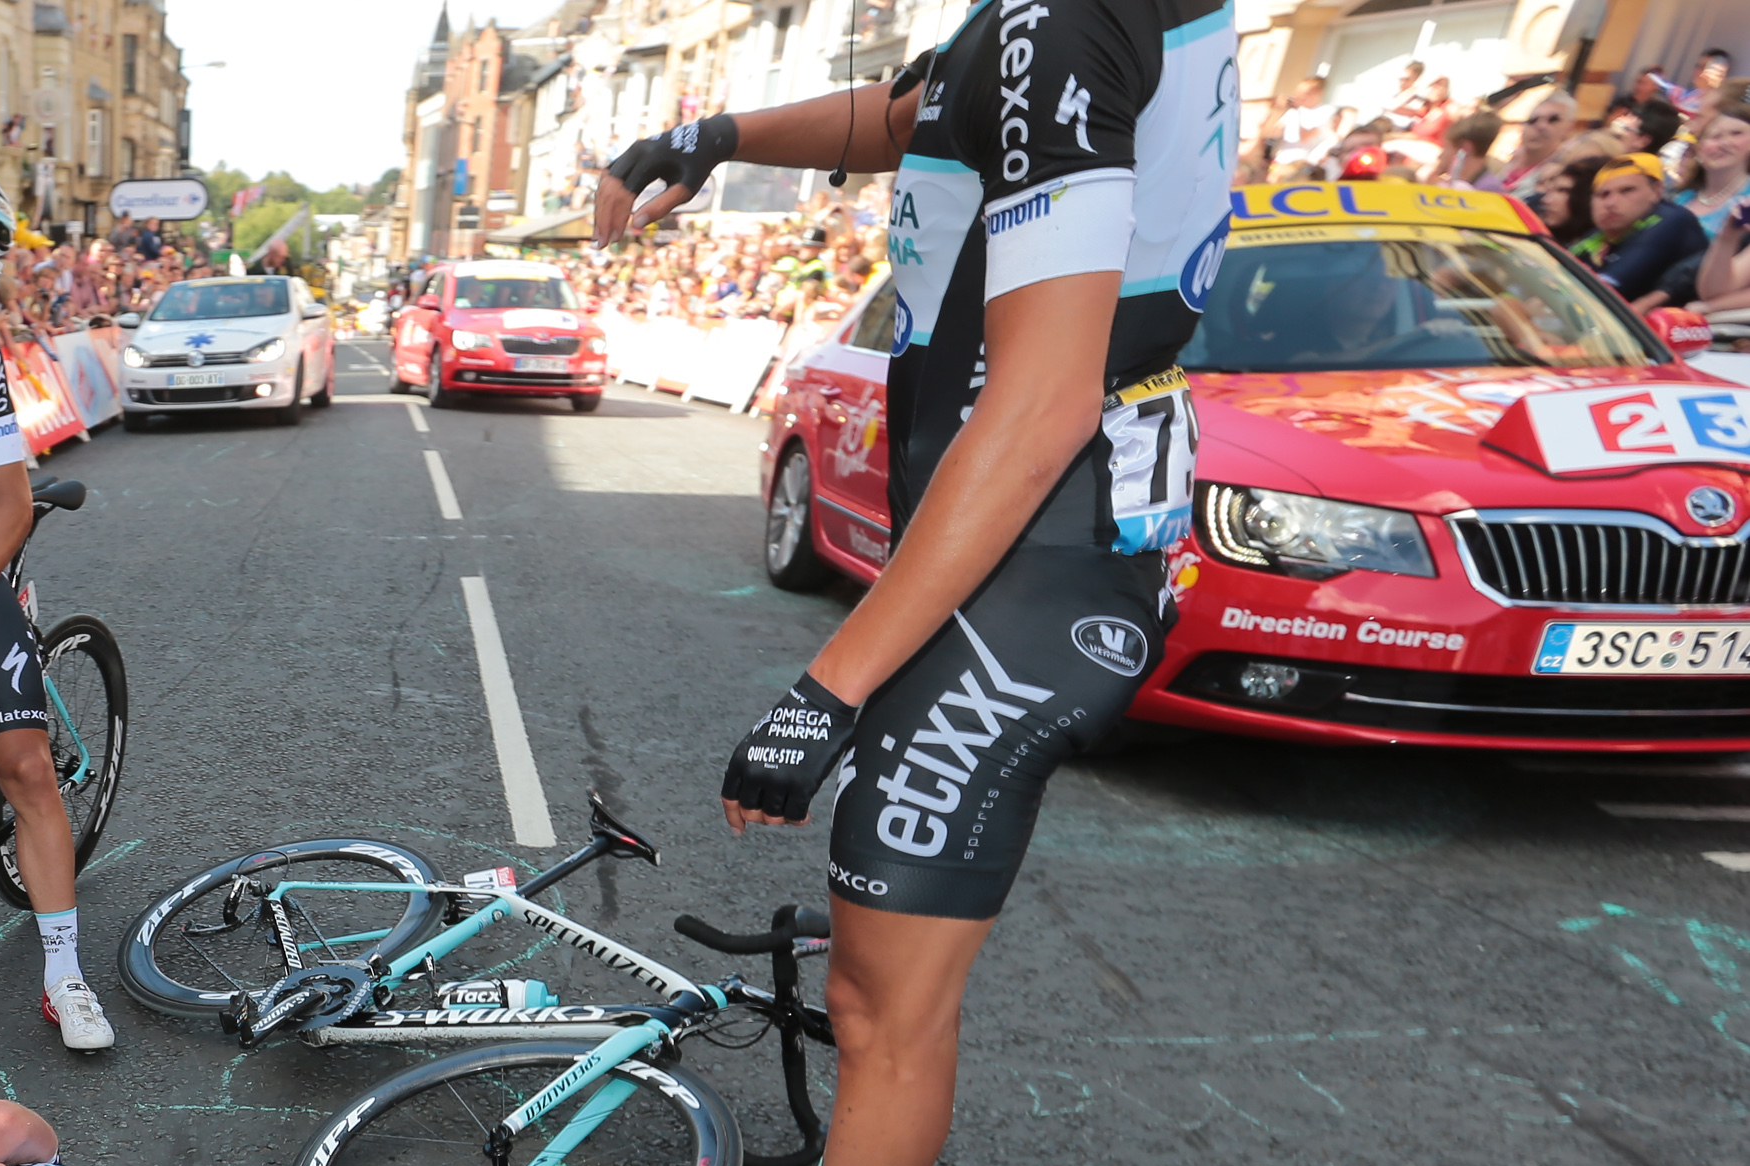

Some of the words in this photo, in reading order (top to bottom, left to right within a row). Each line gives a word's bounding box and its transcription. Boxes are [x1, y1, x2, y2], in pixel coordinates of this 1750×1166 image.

[1000, 0, 1049, 182] texco
[1230, 185, 1388, 219] LCL
[1418, 193, 1477, 211] LCL
[1221, 606, 1347, 640] Direction
[1357, 621, 1465, 651] Course
[1540, 656, 1562, 668] CZ
[768, 723, 829, 741] PHARMA
[773, 707, 832, 727] OMEGA
[876, 608, 1056, 858] etixx
[963, 787, 1000, 860] sports
[1000, 707, 1088, 778] nutrition
[829, 859, 889, 896] exco
[136, 873, 211, 947] ZIPP
[270, 901, 303, 969] SPECIALIZED
[523, 908, 672, 995] SPECIALIZED
[456, 988, 500, 1004] Tacx
[524, 1051, 602, 1121] SPECIALIZED
